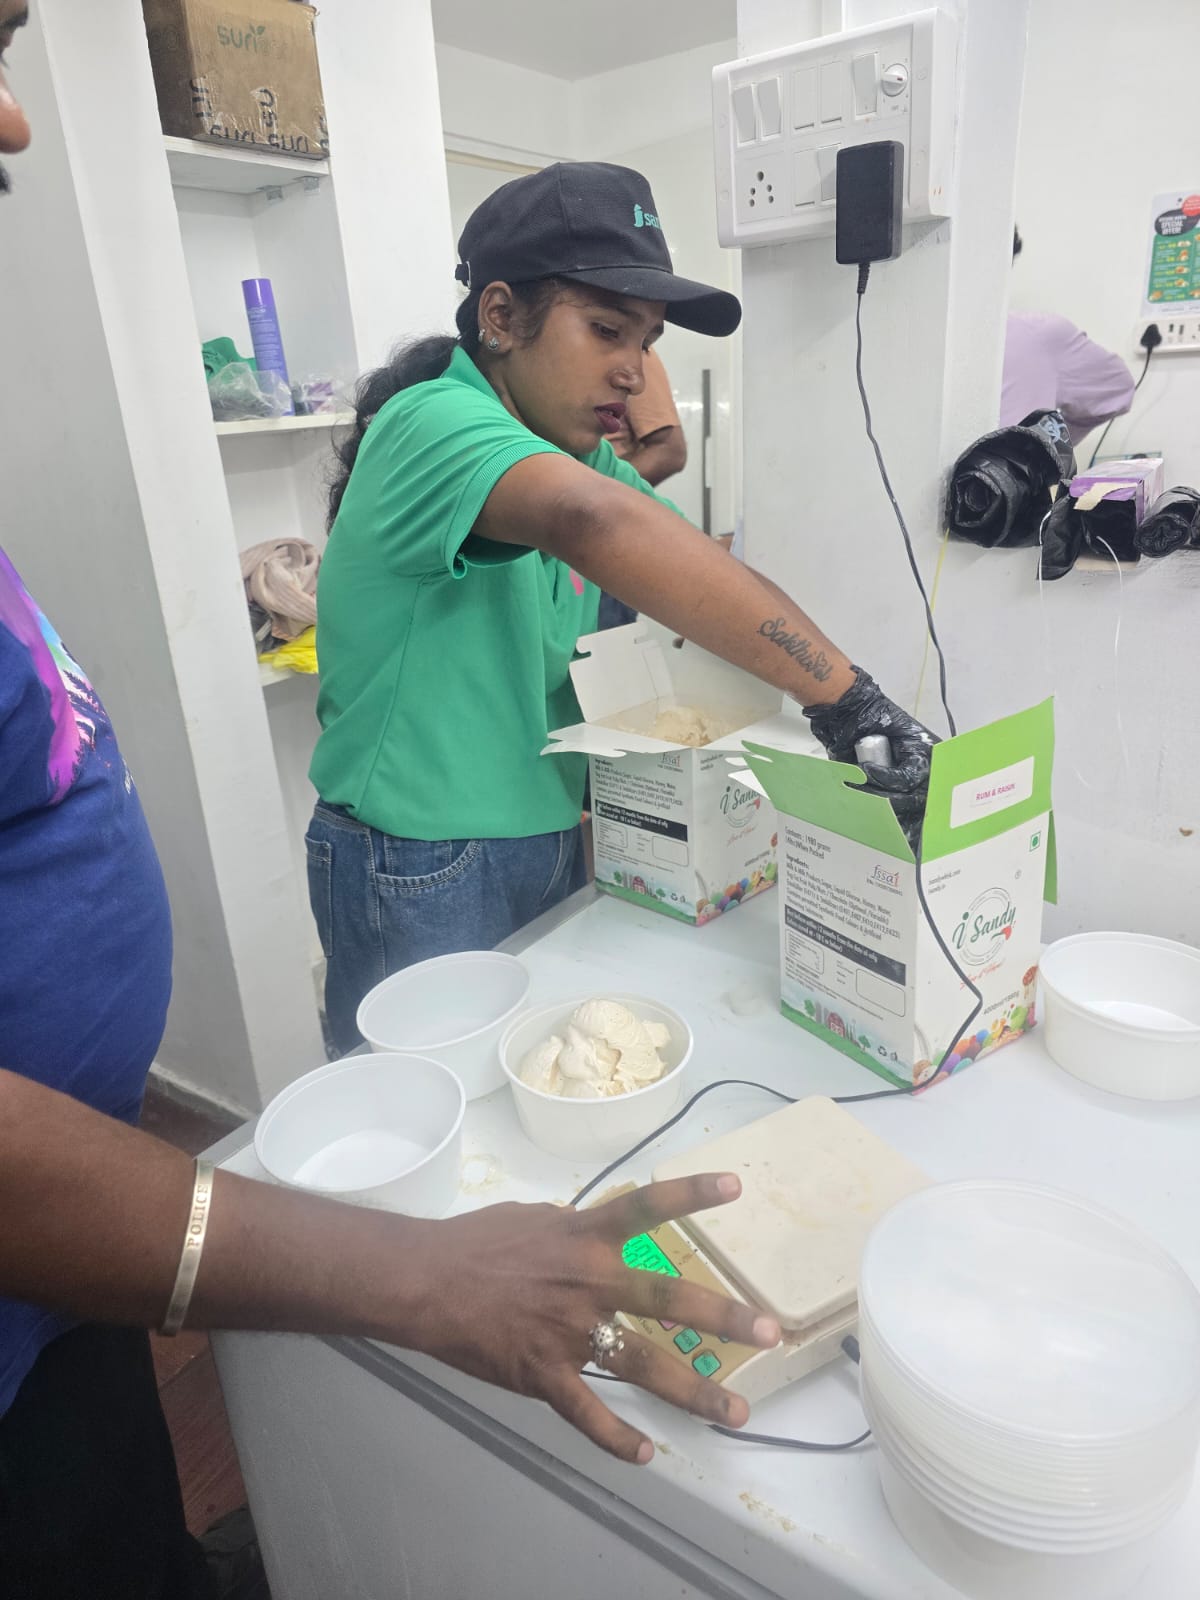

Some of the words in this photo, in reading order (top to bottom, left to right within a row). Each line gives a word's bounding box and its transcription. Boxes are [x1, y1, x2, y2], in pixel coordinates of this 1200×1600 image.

[870, 864, 900, 889] fssai
[970, 901, 1017, 944] Sandy
[187, 1184, 209, 1249] POLICE
